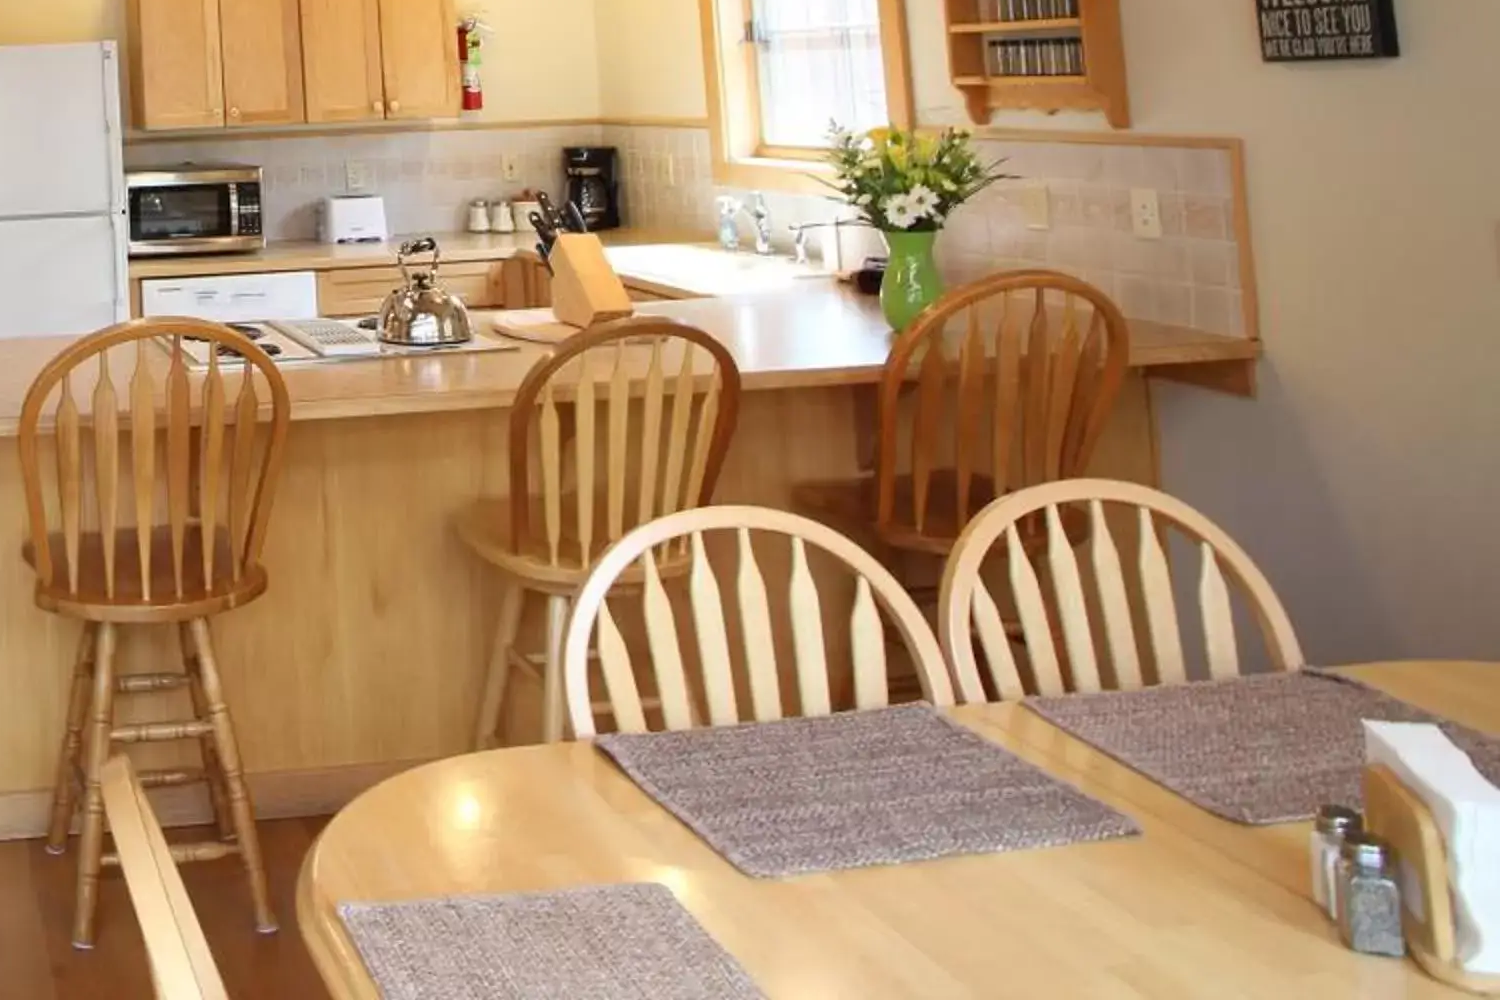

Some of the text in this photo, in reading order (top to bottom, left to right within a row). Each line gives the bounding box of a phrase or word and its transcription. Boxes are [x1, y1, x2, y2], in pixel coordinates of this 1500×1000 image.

[1261, 4, 1371, 37] NICE TO SEE YOU
